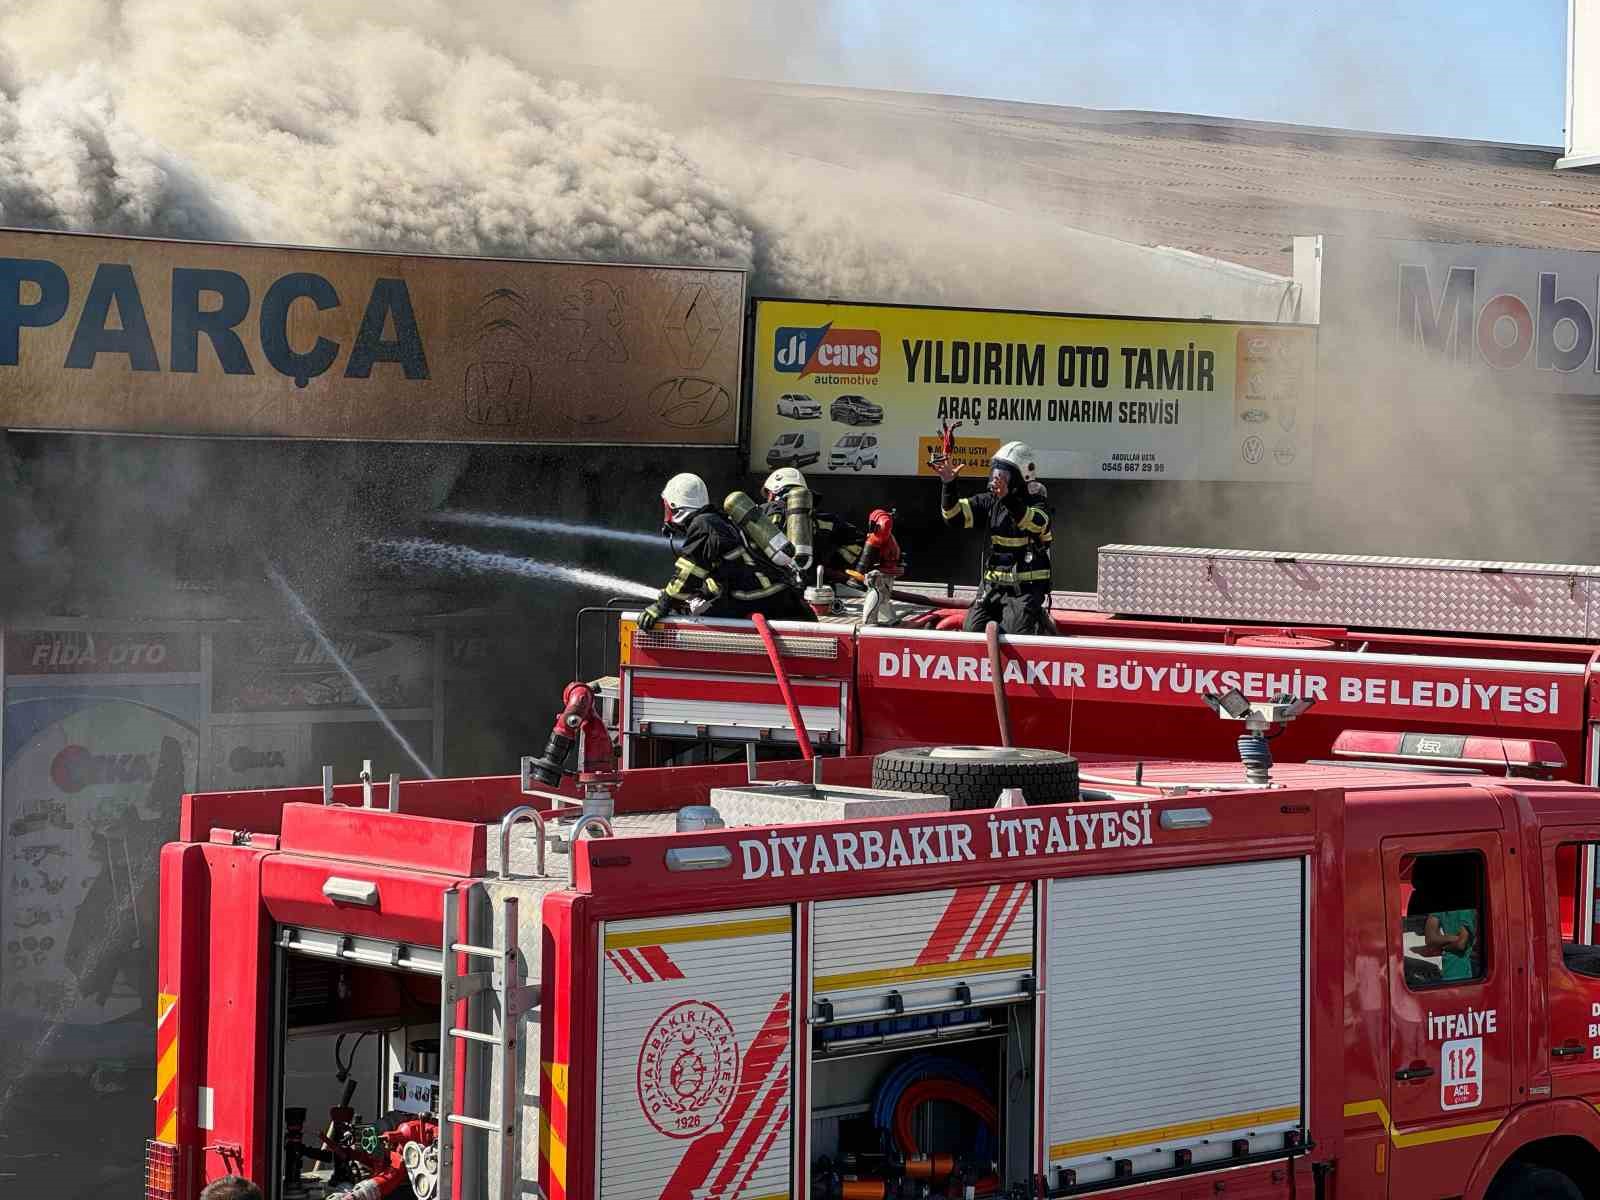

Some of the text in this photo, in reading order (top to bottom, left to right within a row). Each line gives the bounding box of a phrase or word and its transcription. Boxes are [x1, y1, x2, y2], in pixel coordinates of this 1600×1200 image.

[0, 257, 432, 388] PARÇA
[818, 343, 879, 368] cars
[902, 339, 1215, 392] YILDIRIM OTO TAMİR
[814, 374, 880, 386] automotive
[937, 396, 1179, 426] ARAÇ BAKIM ONARIM SERVİSİ
[1339, 676, 1559, 714] BELEDİYESİ
[738, 803, 1153, 880] DİYARBAKIR İTFAİYESİ
[1428, 1006, 1497, 1041] İTFAİYE
[1448, 1047, 1476, 1080] 112
[675, 1115, 701, 1129] 1926
